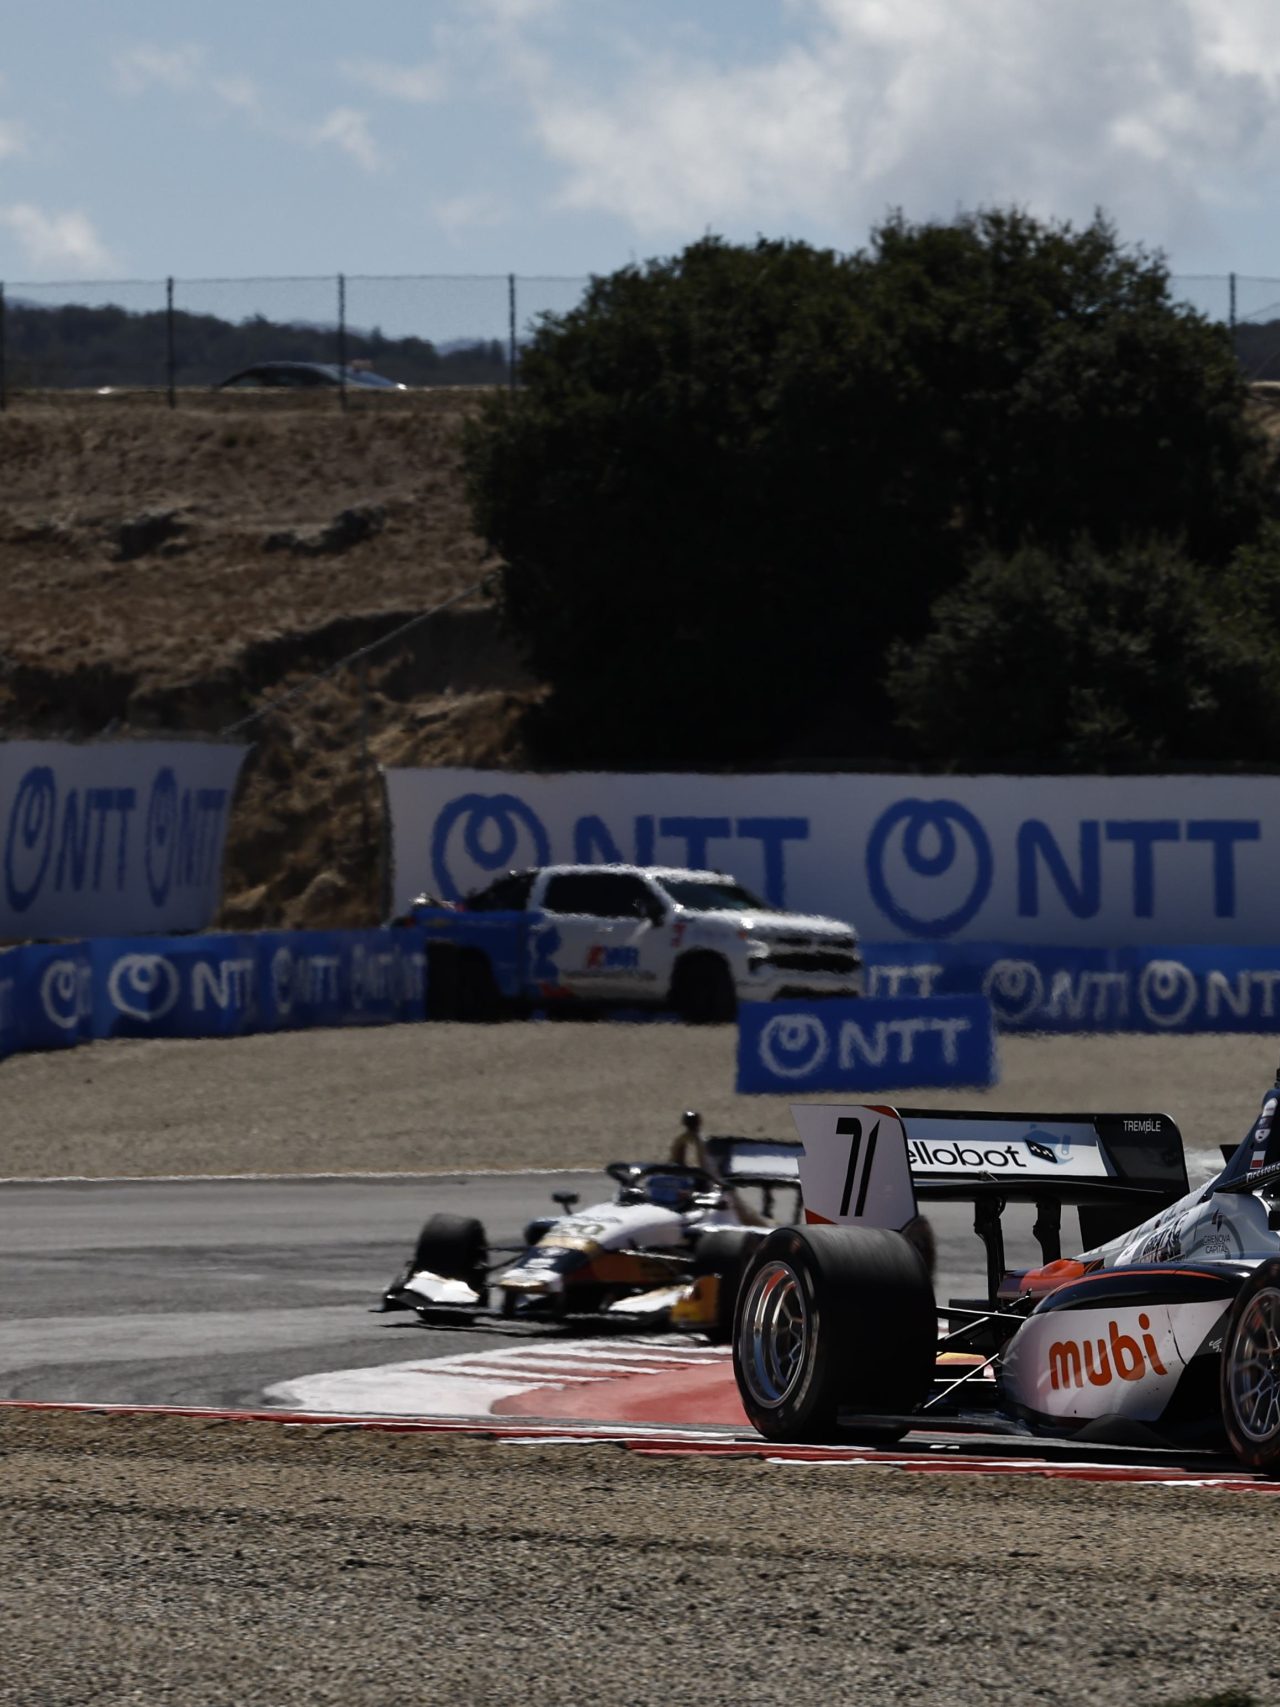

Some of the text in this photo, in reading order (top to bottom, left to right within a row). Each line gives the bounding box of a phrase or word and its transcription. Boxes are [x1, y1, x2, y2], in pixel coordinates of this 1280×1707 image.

[56, 788, 136, 892] NTT
[1016, 819, 1261, 918] NTT
[838, 1019, 972, 1070] NTT
[836, 1117, 880, 1217] 71
[1122, 1119, 1161, 1132] TREMBLE
[1049, 1314, 1169, 1390] mubi
